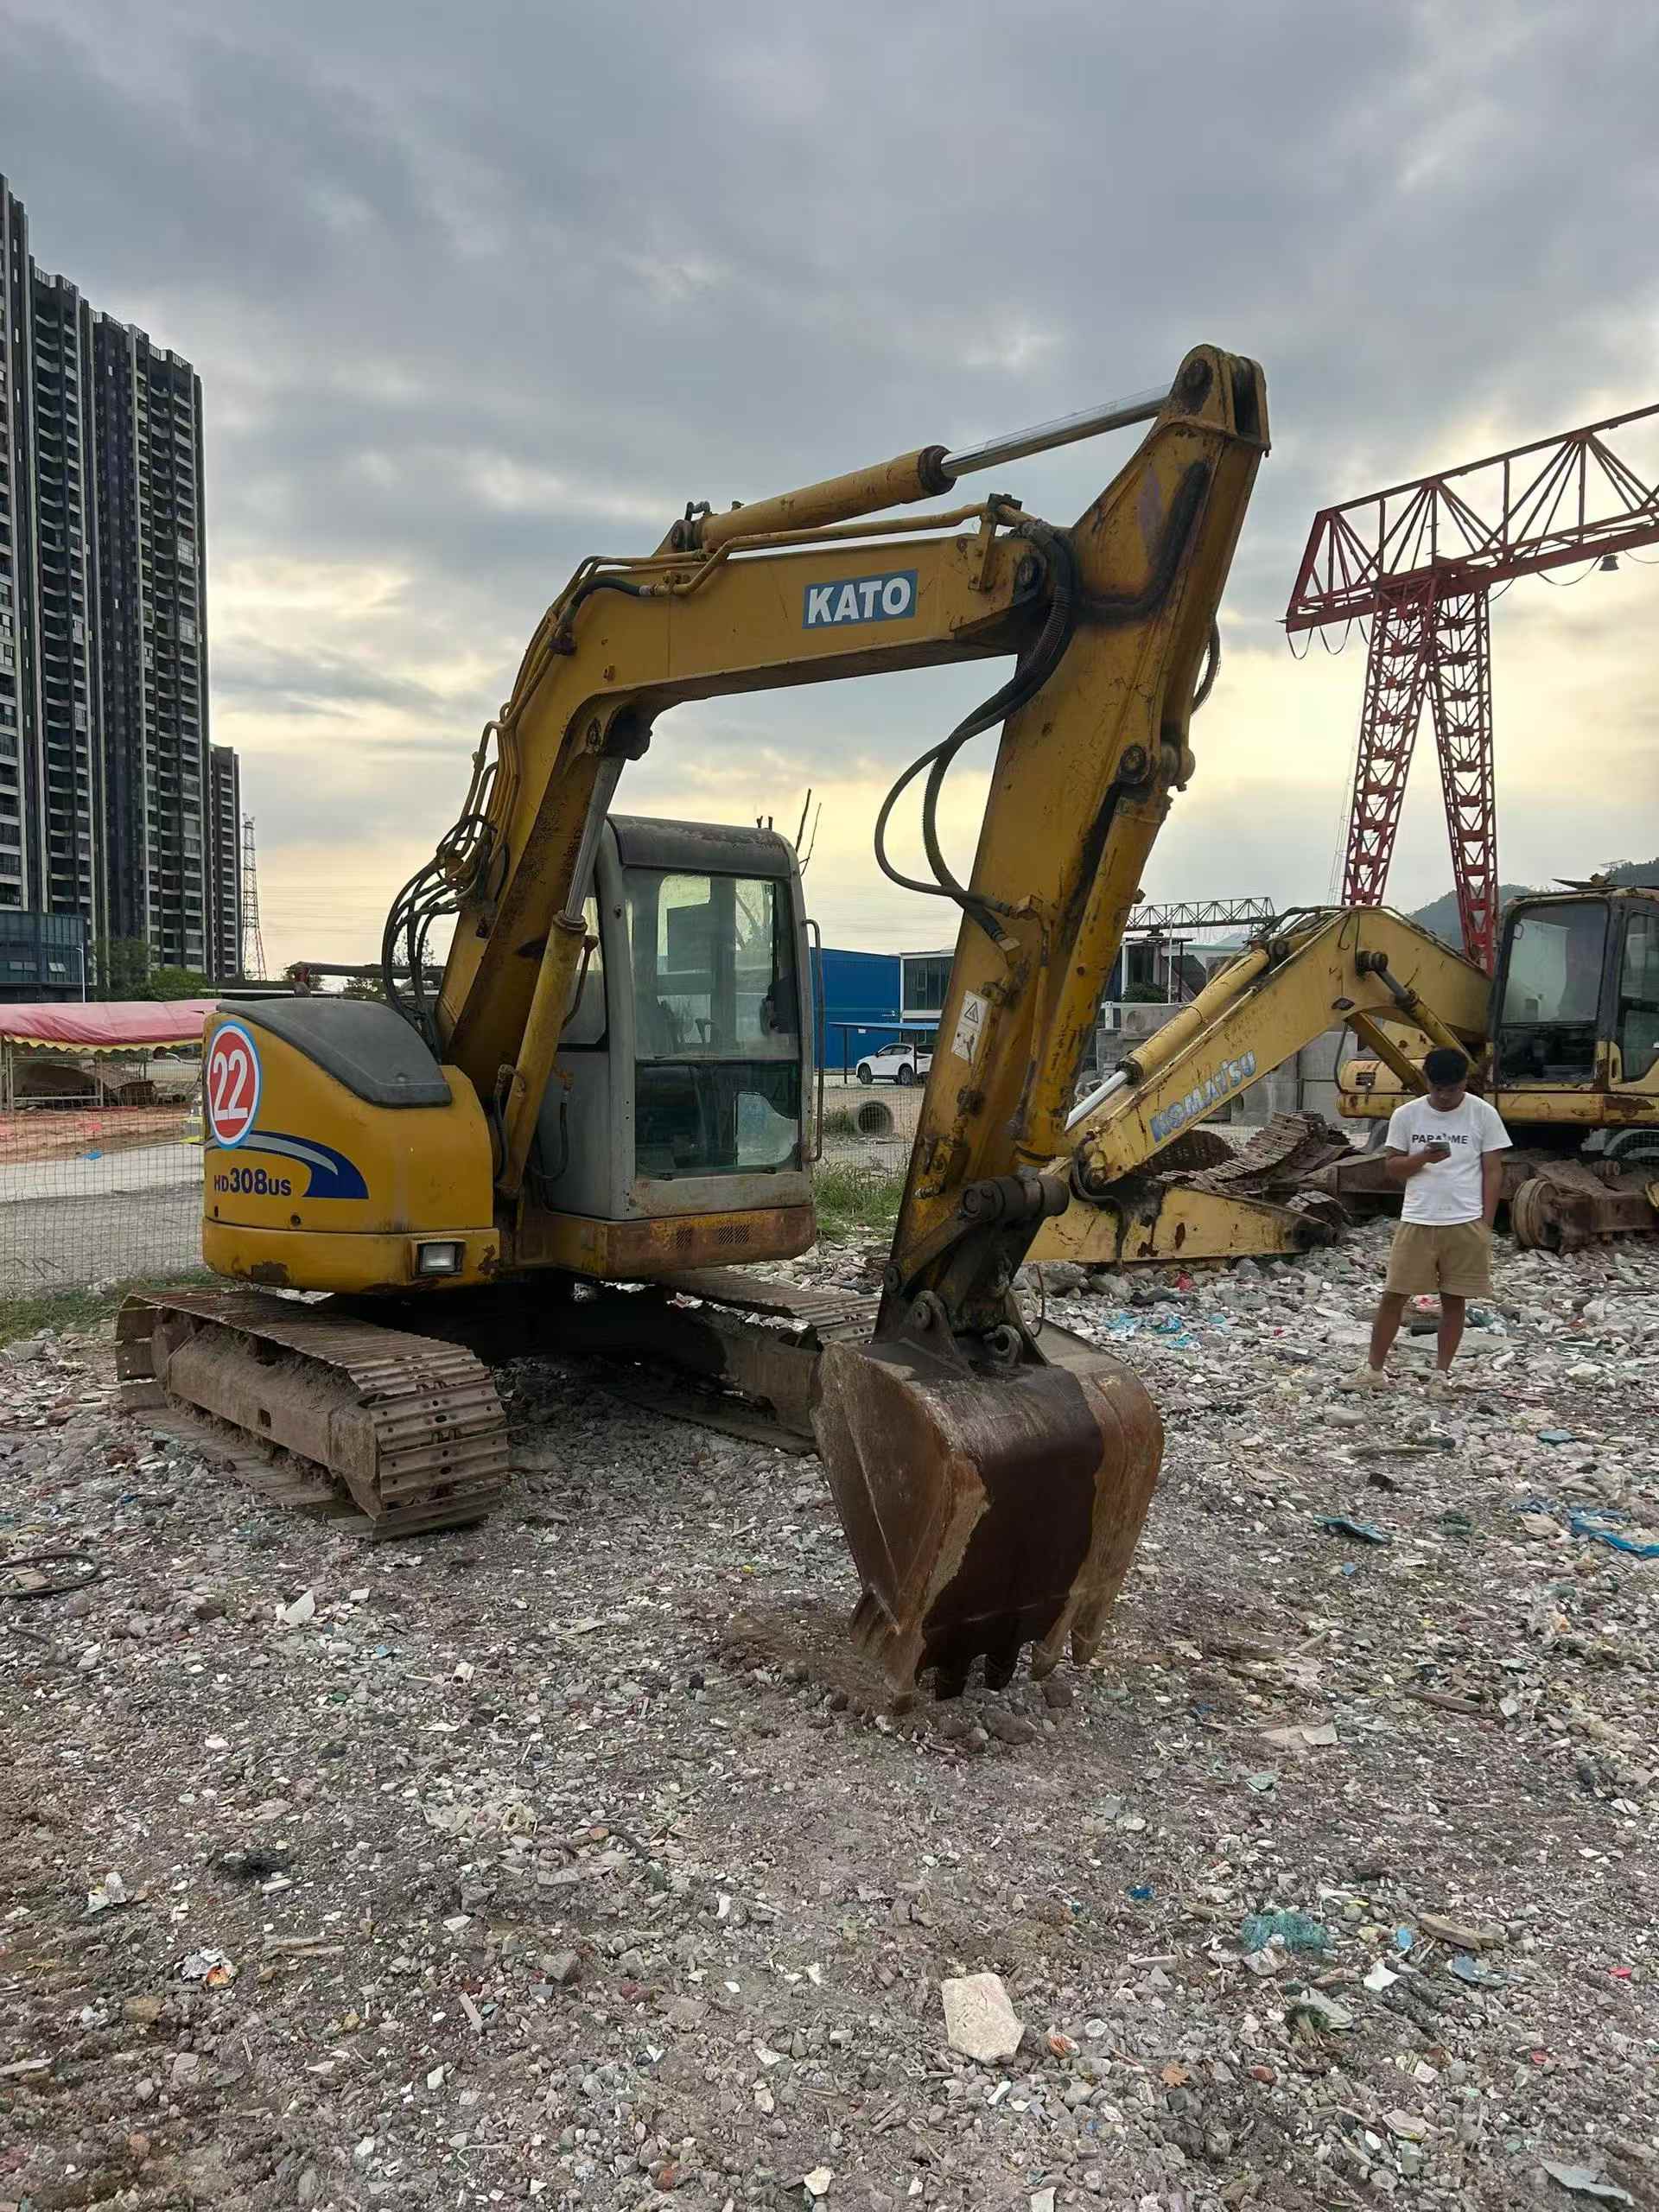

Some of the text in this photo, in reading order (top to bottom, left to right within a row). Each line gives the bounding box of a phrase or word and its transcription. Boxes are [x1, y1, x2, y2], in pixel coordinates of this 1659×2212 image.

[808, 576, 911, 624] KATO
[213, 1049, 249, 1122] 22
[1148, 1049, 1258, 1143] KOMATSU
